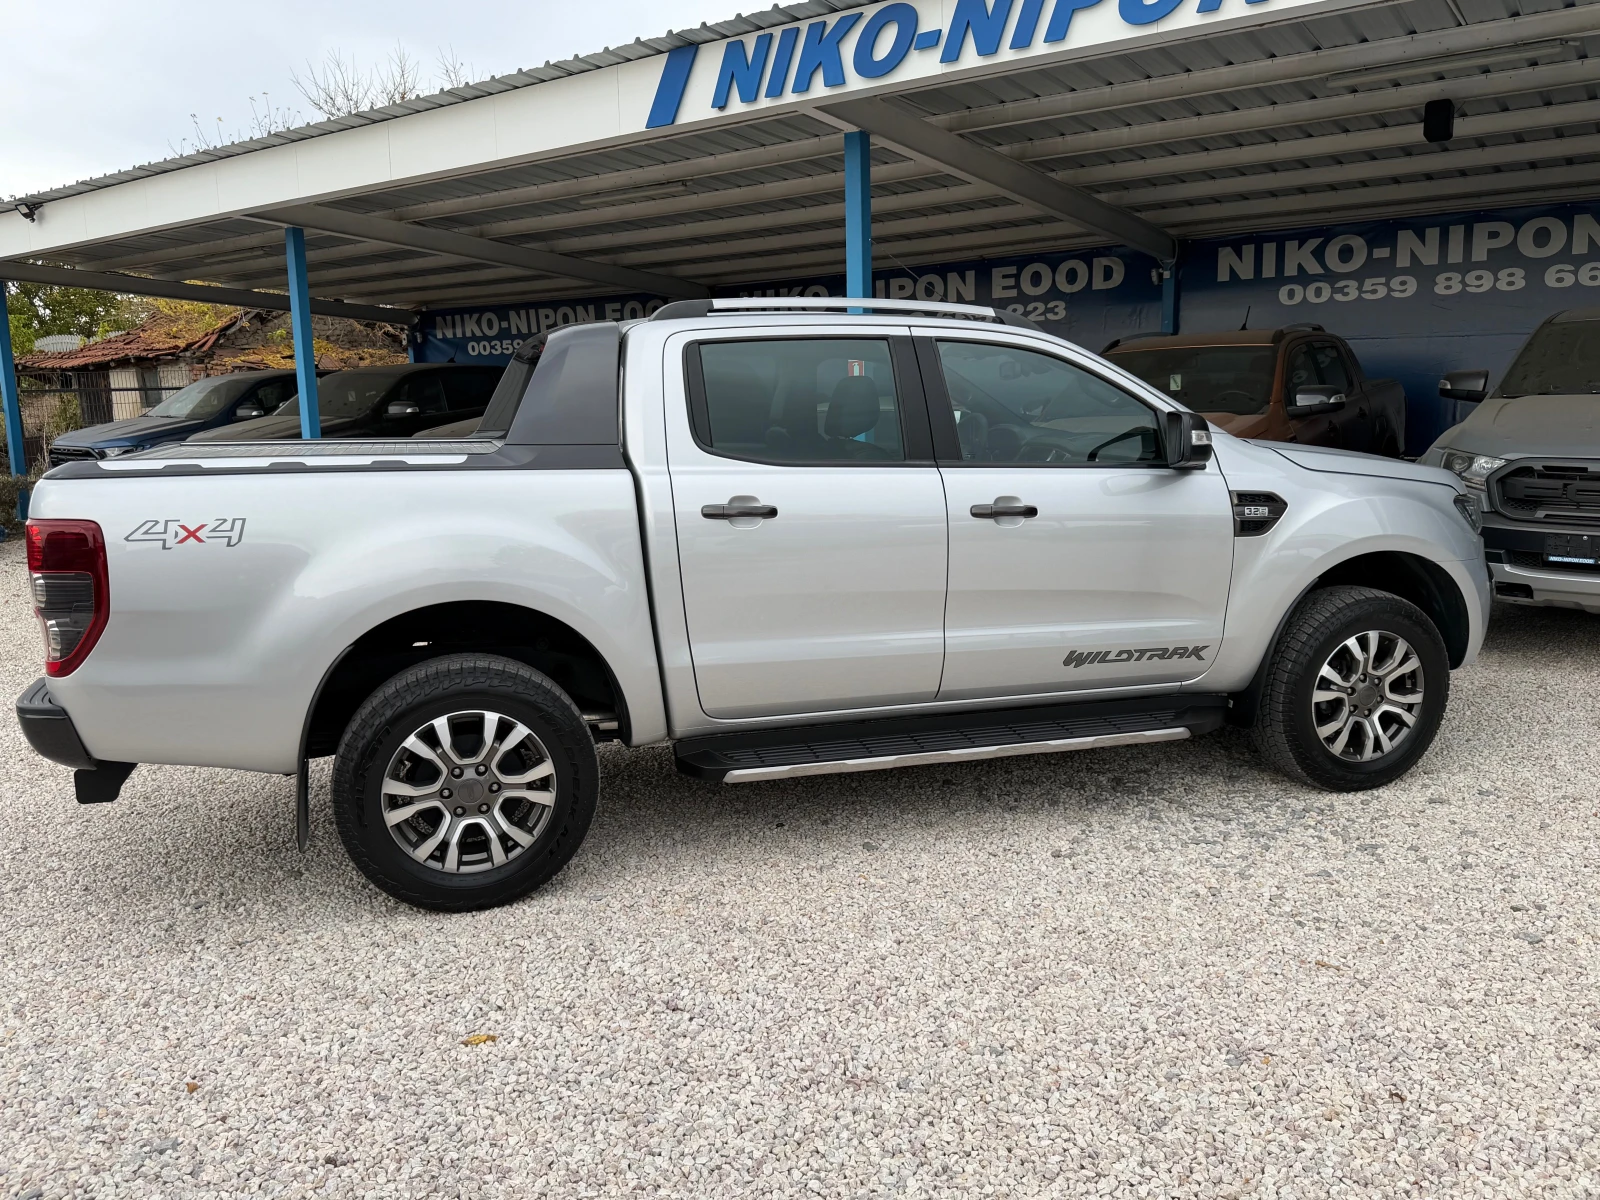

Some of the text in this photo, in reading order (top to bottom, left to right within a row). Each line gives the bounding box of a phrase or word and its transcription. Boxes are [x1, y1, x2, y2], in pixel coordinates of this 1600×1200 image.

[711, 0, 1268, 109] NIKO-NIP
[1217, 212, 1600, 282] NIKO-NIPON
[991, 256, 1125, 299] EOOD
[1278, 275, 1418, 306] 00359
[1434, 267, 1526, 295] 898
[435, 303, 596, 339] NIKO-NIPON
[1063, 645, 1210, 668] WILDTRAK
